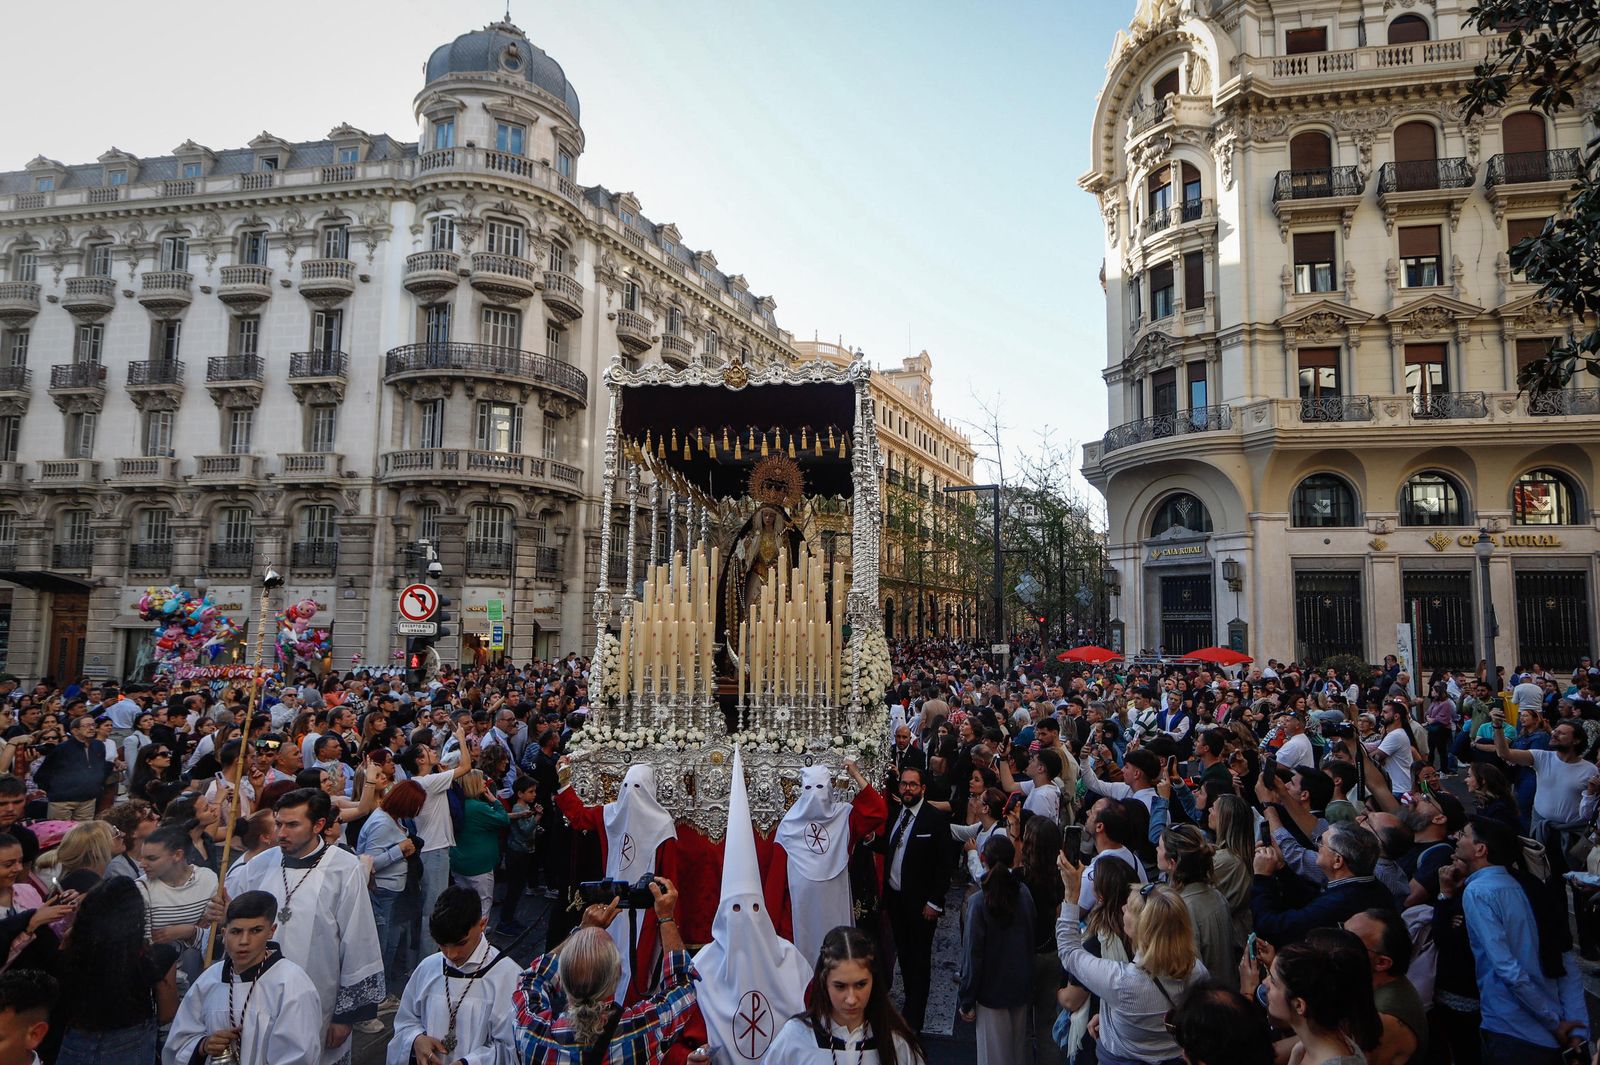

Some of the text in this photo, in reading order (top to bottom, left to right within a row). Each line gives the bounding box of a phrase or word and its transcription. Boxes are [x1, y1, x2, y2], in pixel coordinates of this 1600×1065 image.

[1458, 535, 1561, 547] CAA RURAL
[1179, 546, 1201, 554] RURAL
